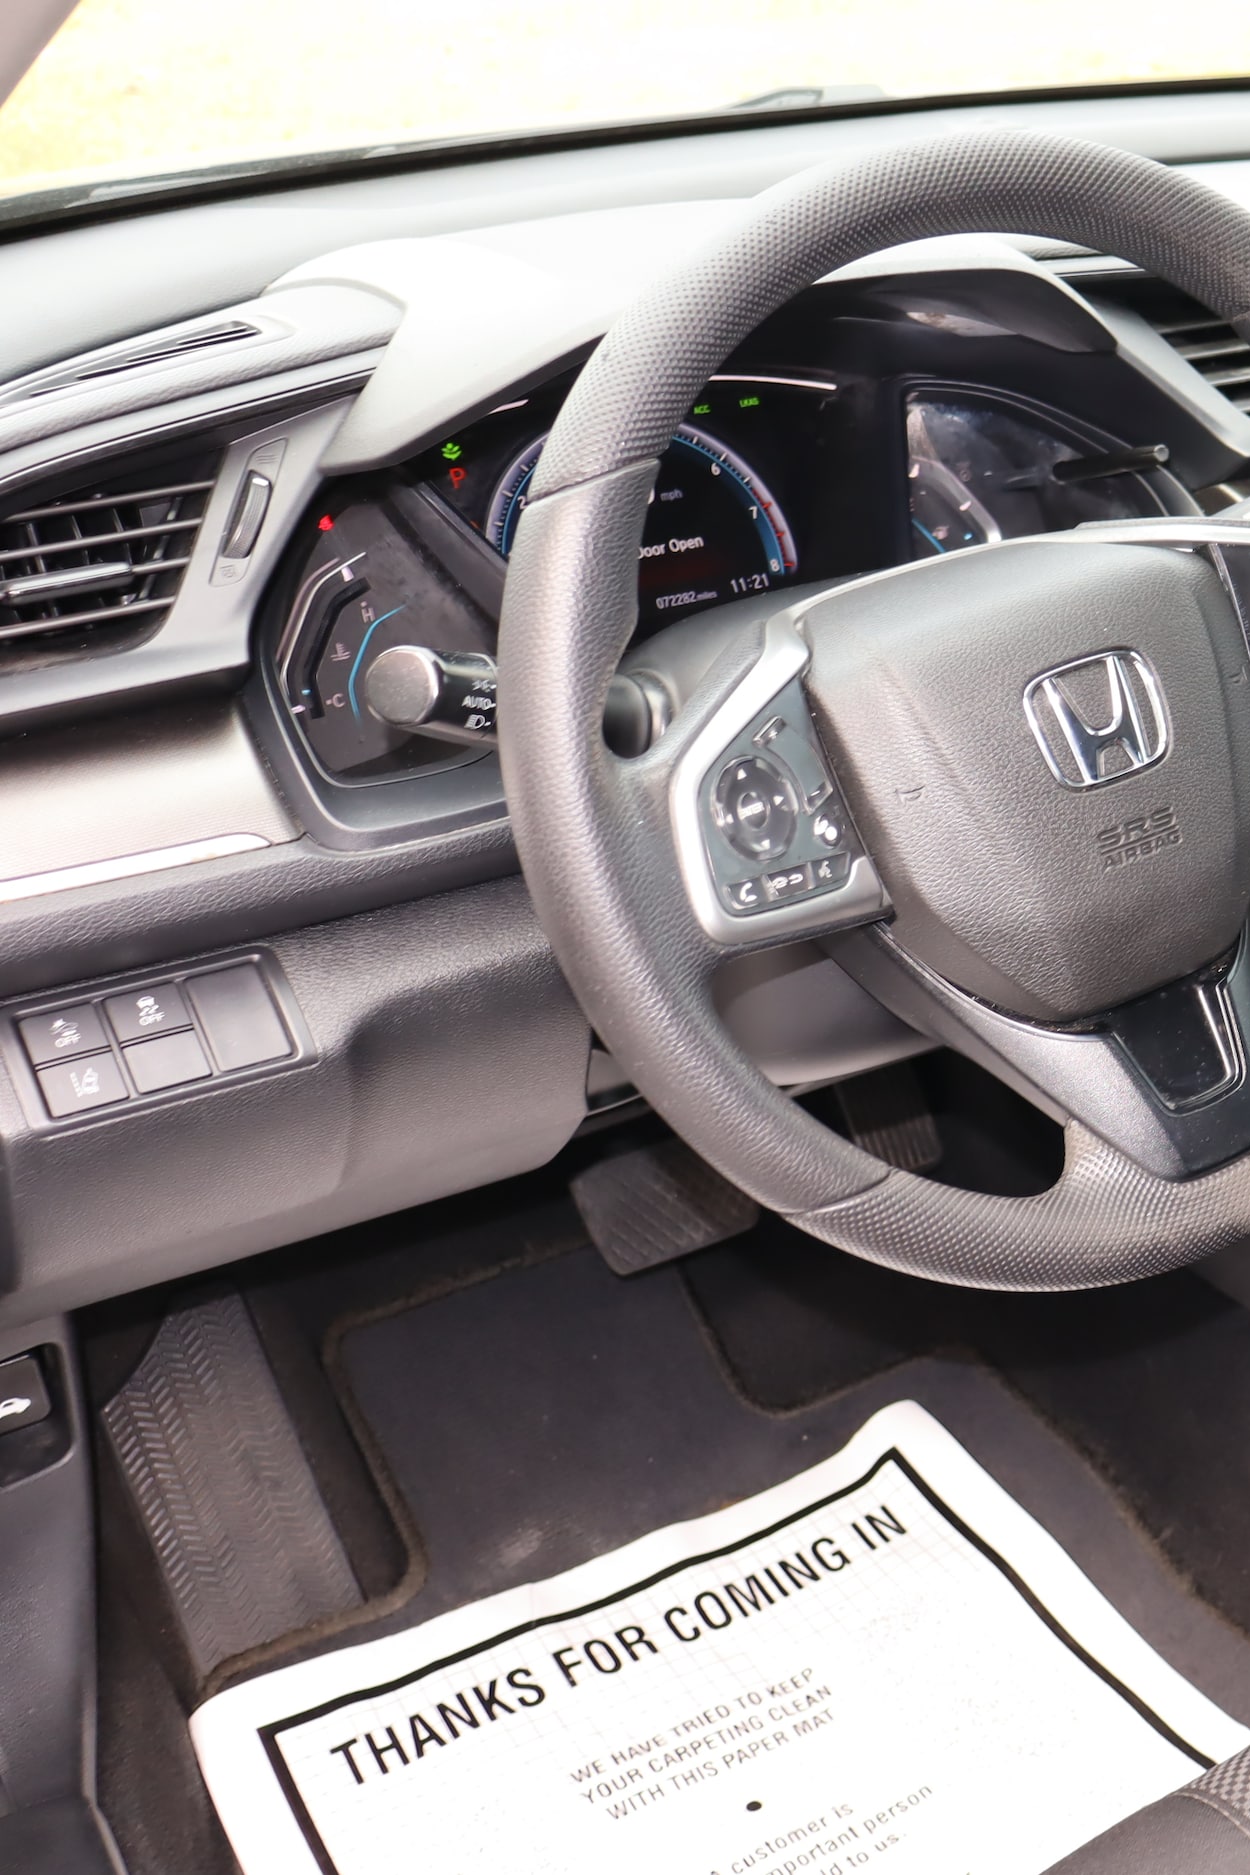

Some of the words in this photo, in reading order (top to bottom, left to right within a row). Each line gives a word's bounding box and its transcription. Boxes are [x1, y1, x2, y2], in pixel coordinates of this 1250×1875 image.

[449, 467, 467, 489] P
[710, 462, 722, 476] 6
[749, 505, 758, 519] 7
[668, 535, 704, 554] Open
[770, 558, 780, 572] 8
[730, 572, 770, 594] 11:21
[461, 694, 492, 710] AUTO
[1098, 805, 1177, 847] SRS
[1102, 829, 1184, 871] AIRBAG
[330, 1668, 546, 1785] THANKS
[552, 1625, 658, 1687] FOR
[664, 1537, 852, 1642] COMING
[852, 1505, 907, 1550] IN
[570, 1759, 606, 1783] WE
[611, 1734, 668, 1765] HAVE
[670, 1704, 731, 1738] TRIED
[736, 1691, 763, 1710] TO
[766, 1667, 813, 1698] KEEP
[580, 1768, 644, 1805] YOUR
[648, 1715, 764, 1773] CARPETING
[768, 1684, 832, 1721] CLEAN
[606, 1783, 665, 1820] WITH
[669, 1761, 719, 1791] THIS
[722, 1730, 789, 1769] PAPER
[792, 1707, 835, 1738] MAT
[862, 1783, 934, 1835] person
[731, 1816, 827, 1875] customer
[832, 1803, 854, 1819] is
[846, 1850, 869, 1868] to
